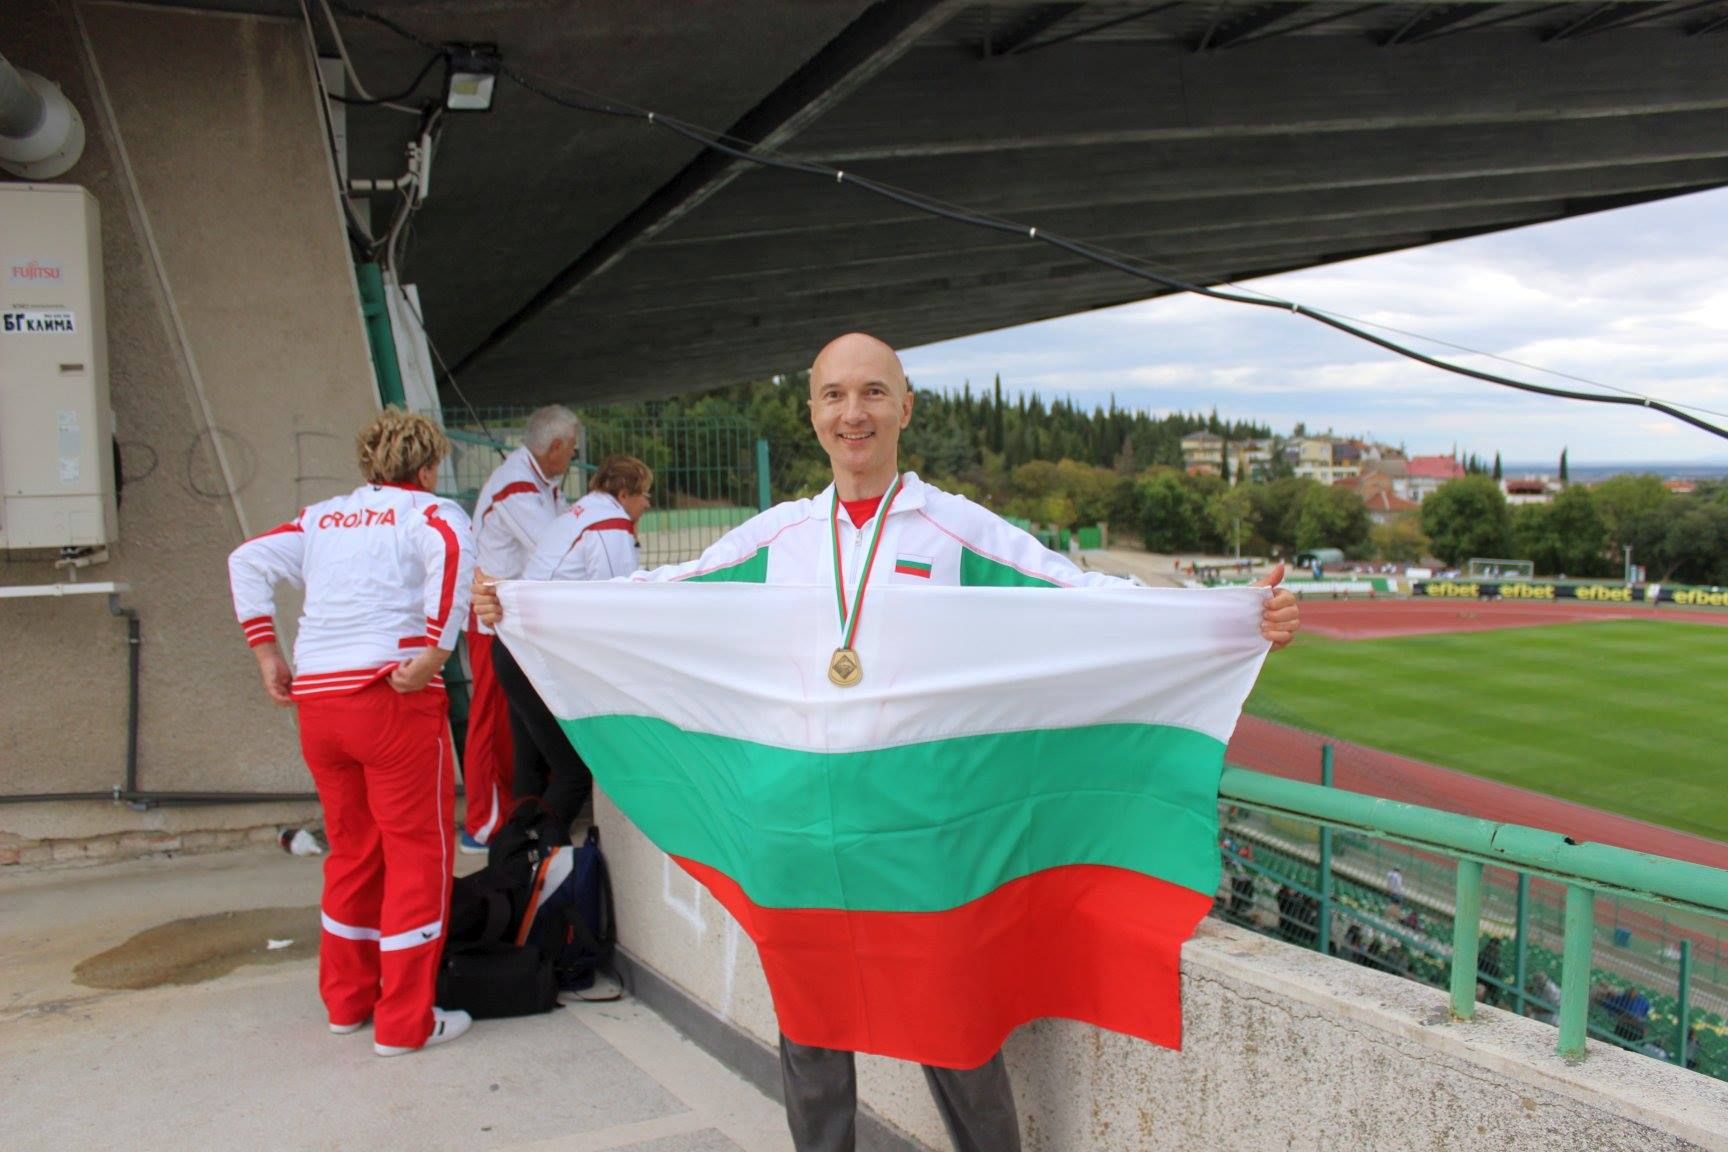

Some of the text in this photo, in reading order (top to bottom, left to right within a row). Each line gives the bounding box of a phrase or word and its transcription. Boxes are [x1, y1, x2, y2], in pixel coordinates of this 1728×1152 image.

[13, 264, 60, 279] FUJITSU
[1426, 582, 1479, 597] efbet
[1500, 584, 1555, 599] efbet
[1575, 585, 1632, 601] efbet
